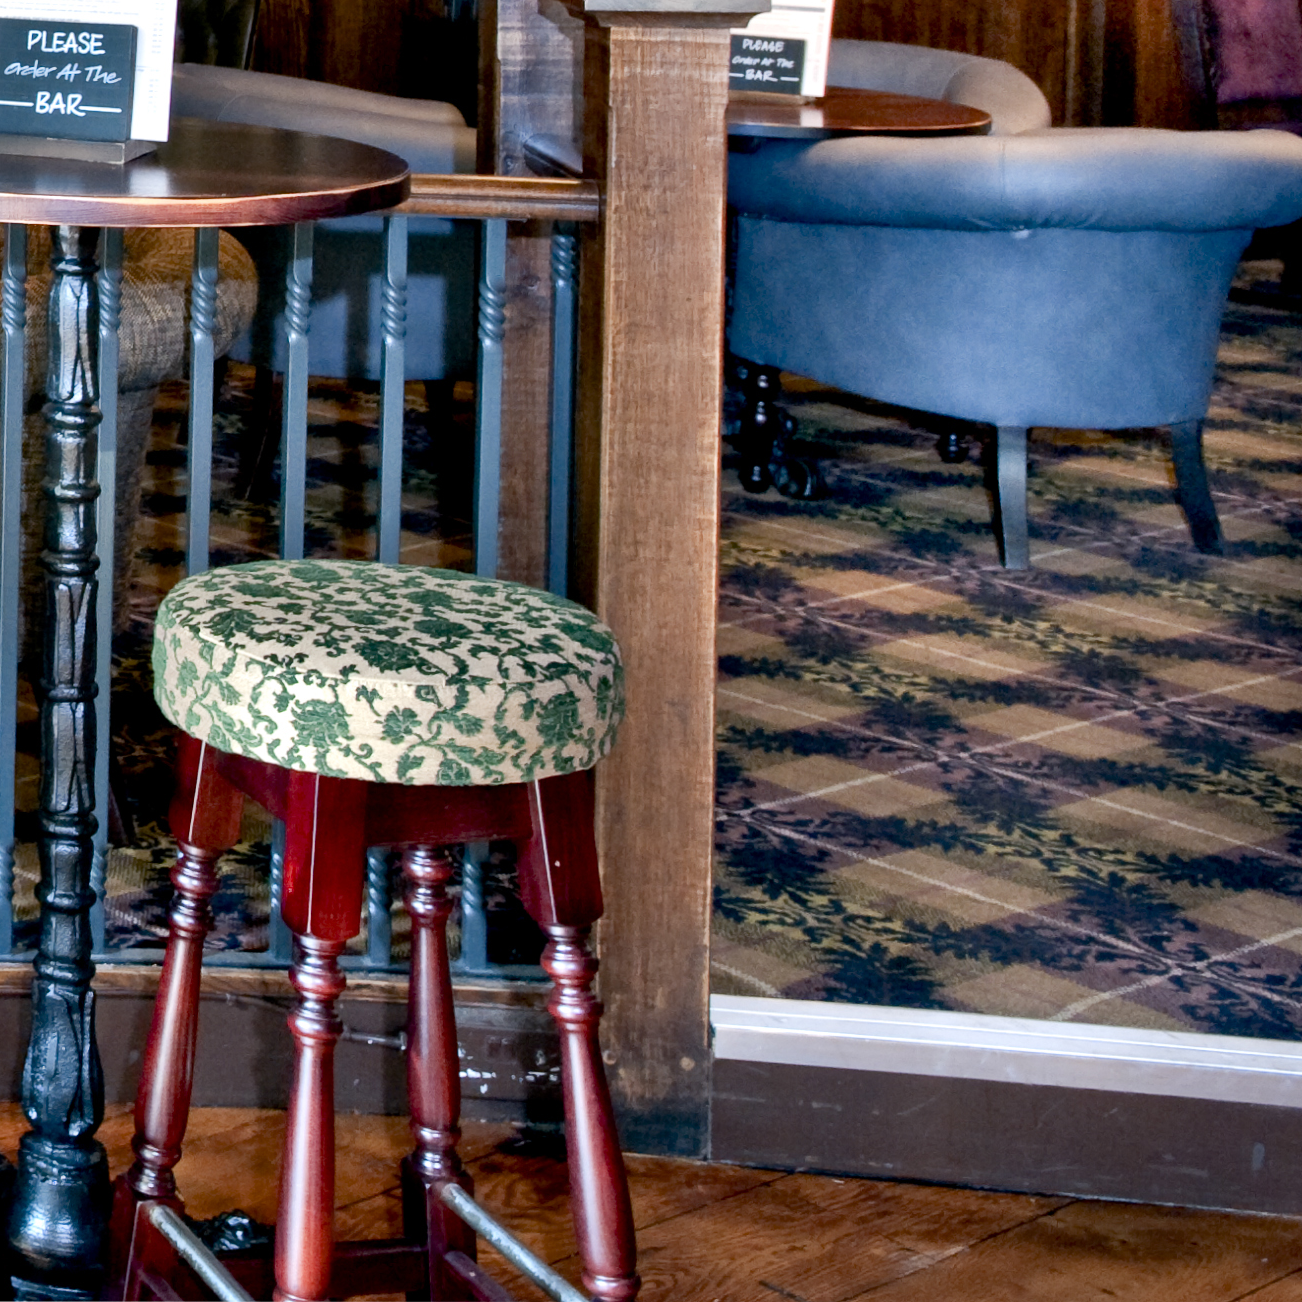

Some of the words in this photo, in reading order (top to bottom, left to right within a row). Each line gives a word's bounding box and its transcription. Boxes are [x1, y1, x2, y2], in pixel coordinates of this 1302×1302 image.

[27, 30, 105, 55] PLEASE
[742, 38, 785, 53] PLEASE
[56, 65, 82, 82] At
[84, 66, 122, 84] The
[745, 68, 778, 82] BAR
[35, 91, 87, 117] BAR
